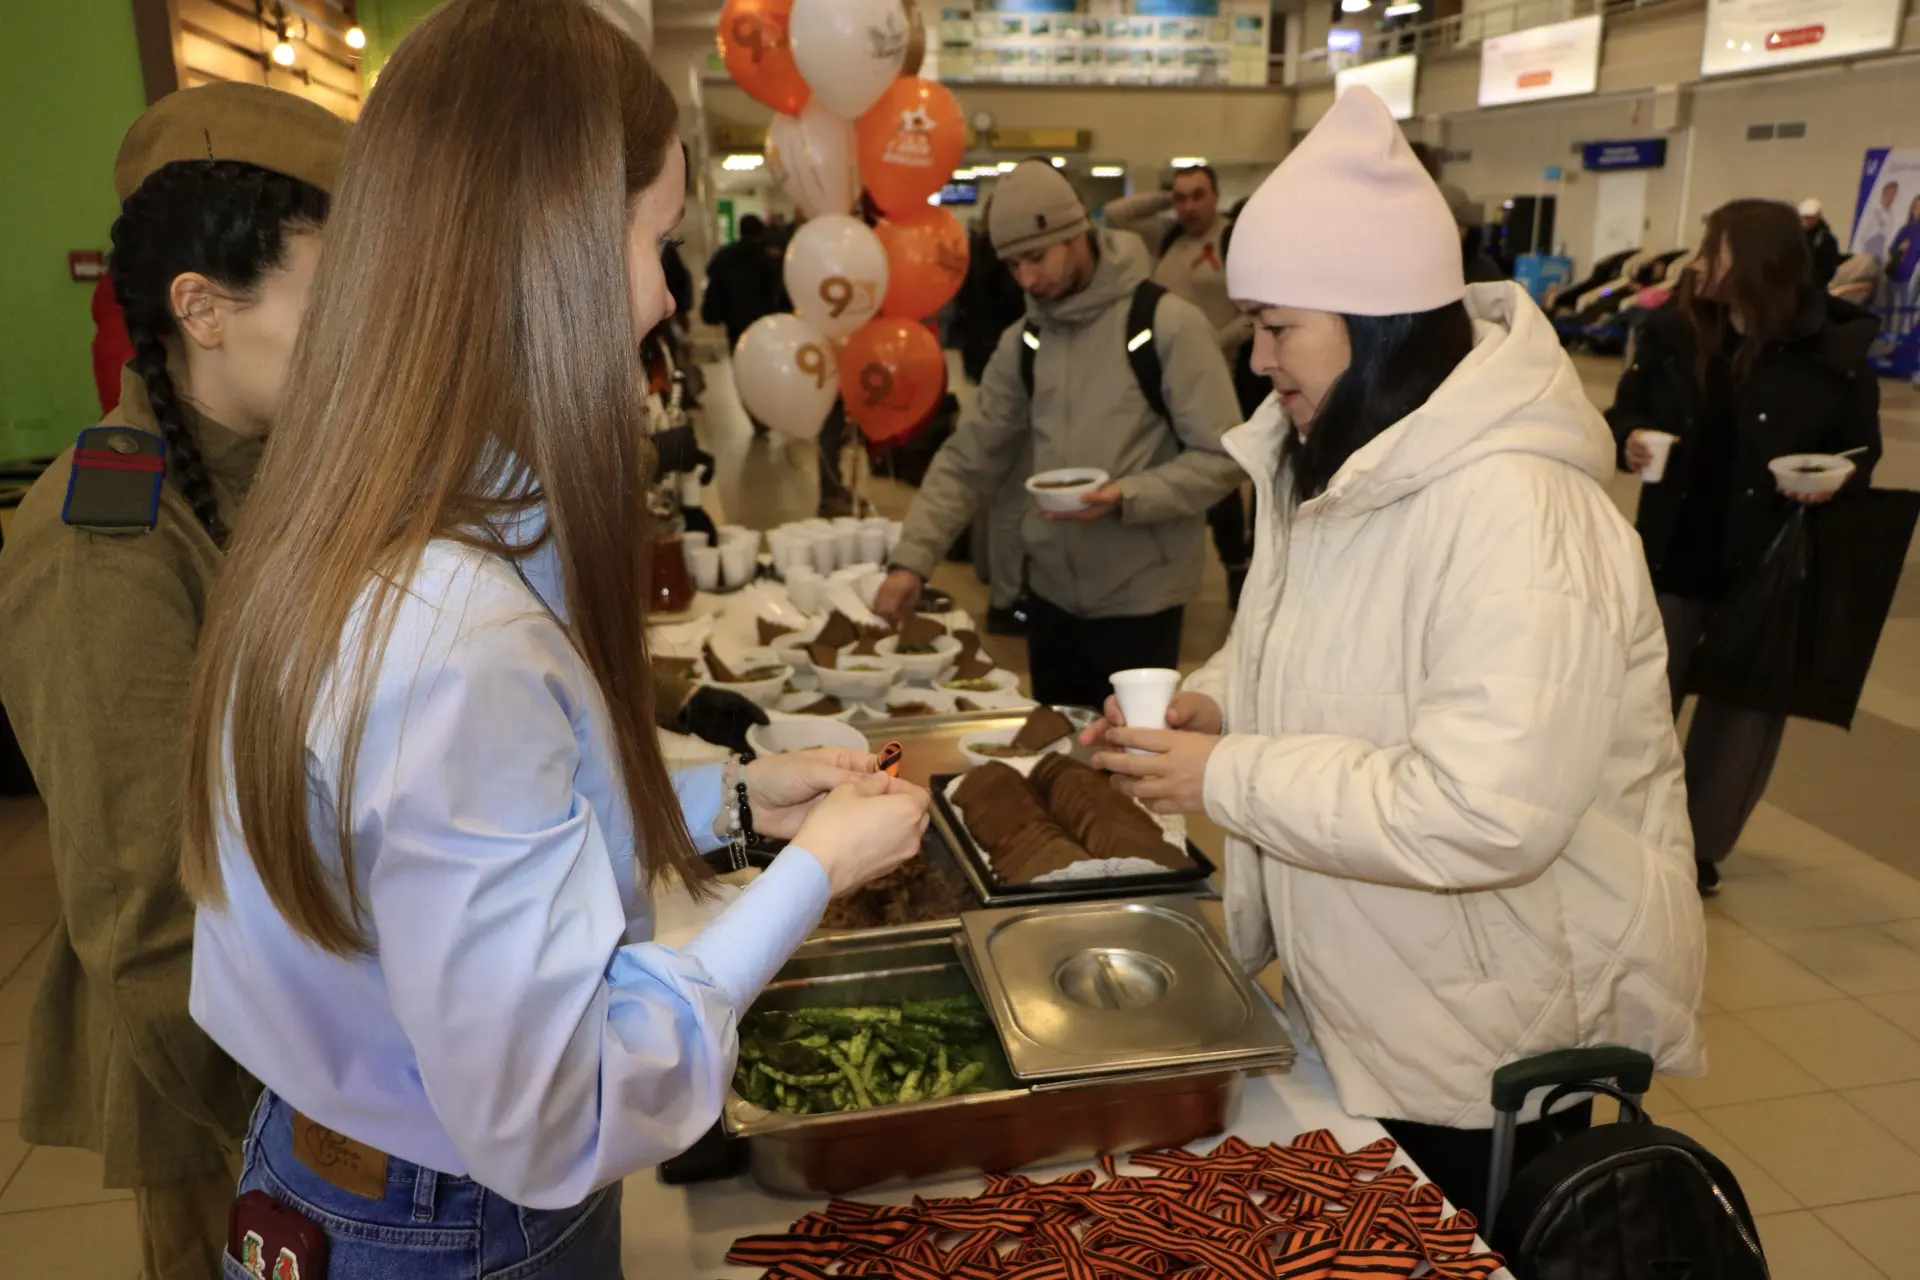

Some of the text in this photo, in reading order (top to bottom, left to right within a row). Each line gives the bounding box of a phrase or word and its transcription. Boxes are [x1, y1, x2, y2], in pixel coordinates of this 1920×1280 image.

[819, 276, 853, 318] 9
[796, 344, 826, 389] 9
[860, 362, 893, 407] 9
